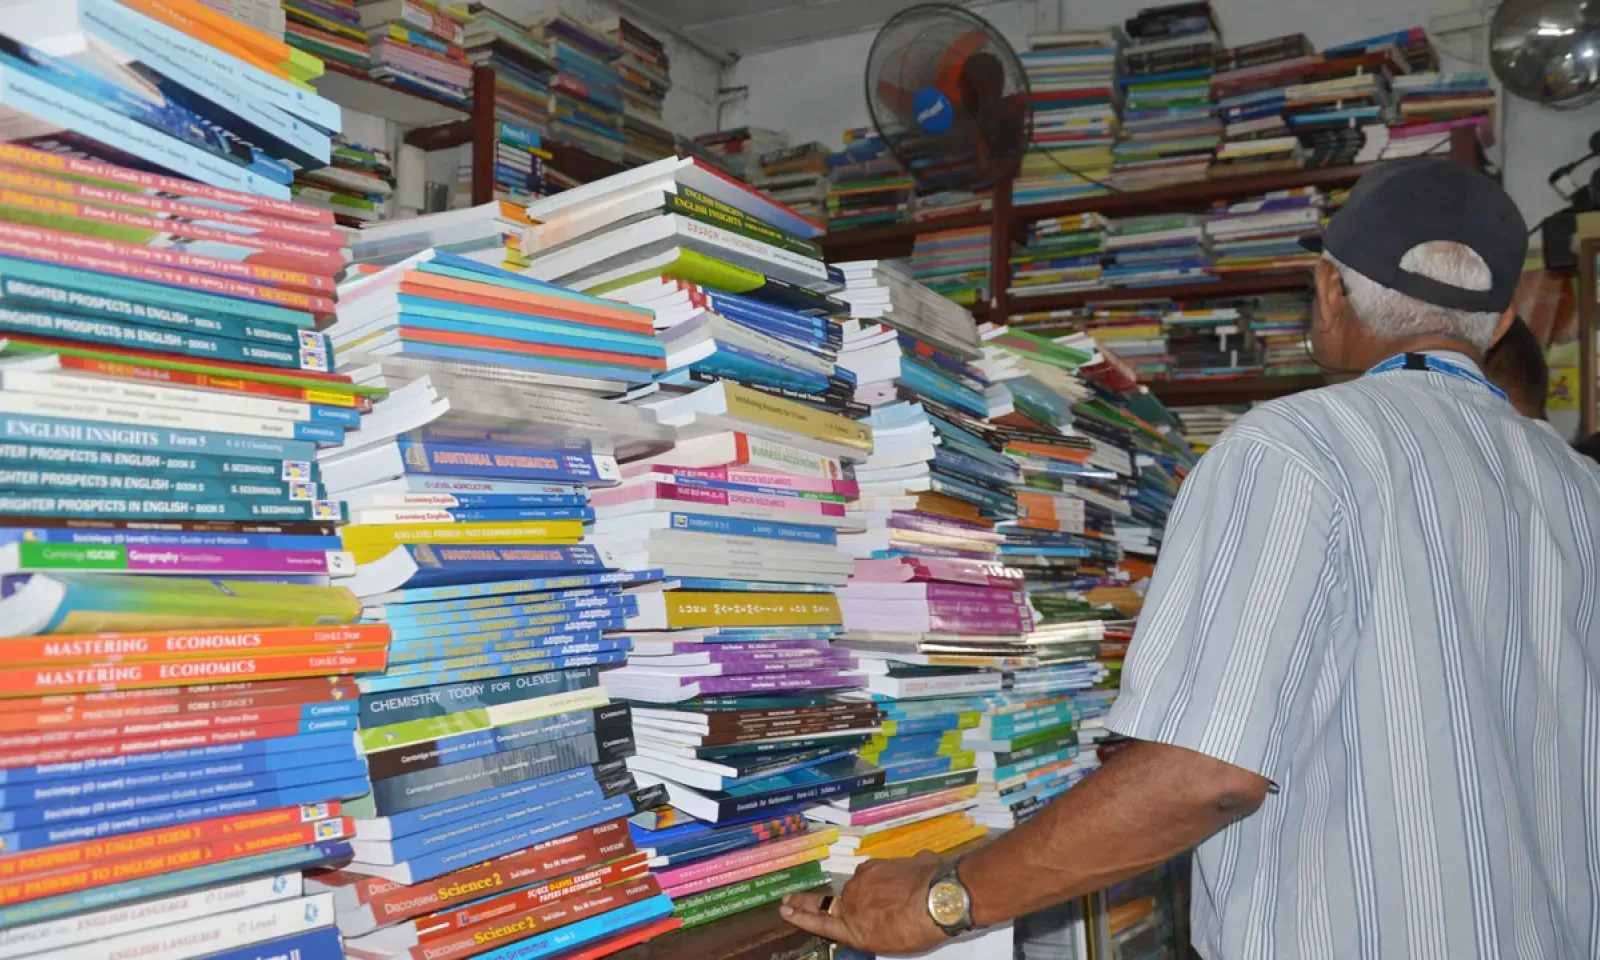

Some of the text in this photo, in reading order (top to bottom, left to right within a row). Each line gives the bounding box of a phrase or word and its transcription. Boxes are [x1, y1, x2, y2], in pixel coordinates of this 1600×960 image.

[674, 196, 742, 228] ENGLISH INSIGHTS
[688, 222, 720, 240] DESIGN
[7, 280, 188, 324] BRIGHTER PROSPECTS IN ENGLISH
[56, 318, 182, 346] PROSPECTS IN ENGLISH
[6, 419, 82, 441] ENGLISH
[86, 426, 159, 446] INSIGHTS
[170, 432, 197, 446] Form
[200, 435, 206, 448] 5
[30, 446, 98, 463] PROSPECTS
[100, 452, 112, 464] IN
[114, 452, 160, 467] ENGLISH
[434, 451, 494, 466] ADDITIONAL
[752, 445, 780, 459] BUSINESS
[41, 472, 108, 488] PROSPECTS
[110, 476, 122, 488] IN
[124, 478, 170, 490] ENGLISH
[730, 474, 792, 486] COMPUTER SCIENCE
[58, 498, 126, 512] PROSPECTS
[128, 500, 140, 512] IN
[143, 500, 189, 512] ENGLISH
[404, 496, 457, 504] Learning English
[730, 494, 785, 508] COMPUTER SCIENCE
[428, 512, 452, 522] English
[129, 550, 178, 564] Geography
[44, 633, 262, 656] MASTERING ECONOMICS
[36, 660, 256, 685] MASTERING ECONOMICS
[370, 670, 586, 713] CHEMISTRY TODAY FOR O-LEVEL Volume
[401, 752, 428, 764] Cambridge
[593, 824, 619, 835] PEARSON
[599, 842, 625, 854] PEARSON
[574, 866, 612, 883] EXAMINATION
[438, 877, 493, 900] Science
[493, 872, 504, 885] 2
[539, 891, 562, 903] PAPERS
[568, 877, 602, 894] ECONOMICS
[626, 884, 650, 896] PEARSON
[726, 884, 751, 897] Secondary
[474, 920, 526, 944] Science
[526, 916, 536, 928] 2
[506, 939, 549, 960] Grammar
